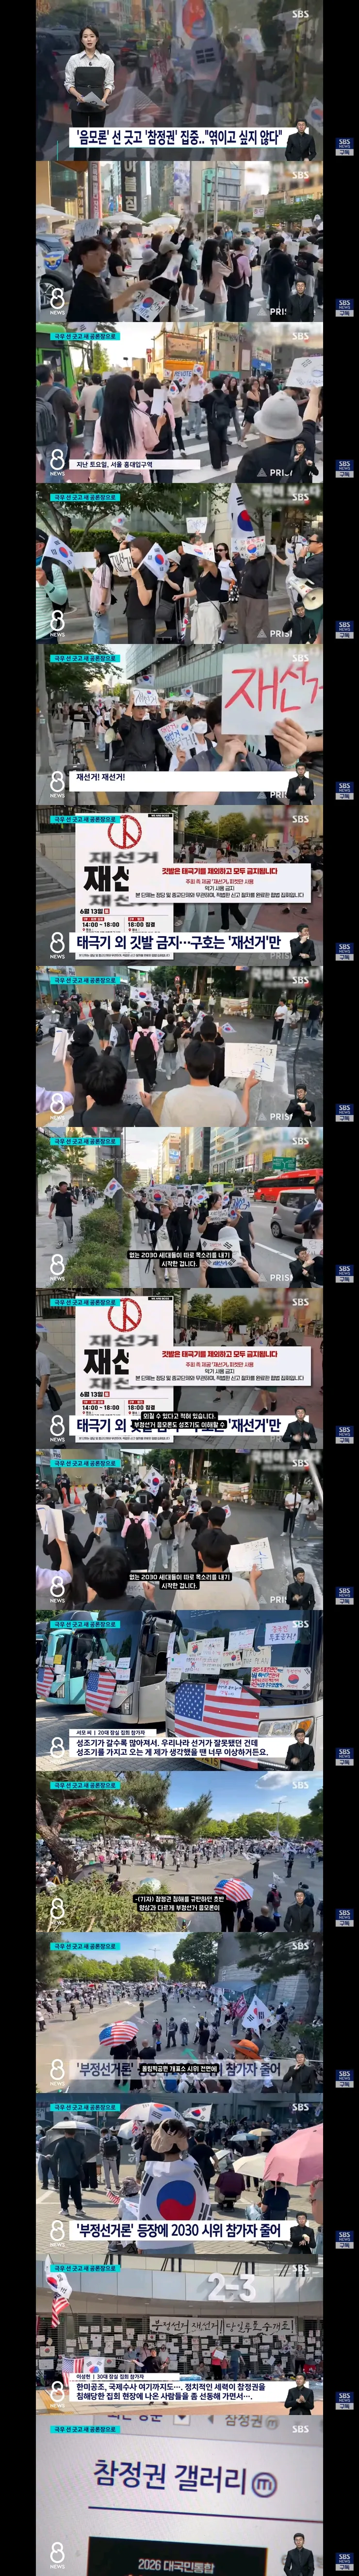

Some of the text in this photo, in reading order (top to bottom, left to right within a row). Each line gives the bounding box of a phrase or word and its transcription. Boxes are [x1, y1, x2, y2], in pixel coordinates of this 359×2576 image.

[134, 689, 157, 704] 재선거
[161, 724, 176, 734] 재선거
[164, 730, 180, 742] 재선거
[83, 866, 129, 891] 재선
[232, 1198, 250, 1210] 재선거
[269, 1633, 295, 1641] 투표금지!
[245, 1649, 264, 1657] TRUST
[208, 2273, 256, 2301] 2-3
[152, 2319, 223, 2336] 부정선거 재선거!
[226, 2320, 294, 2333] 당일투표 수개표!
[94, 2459, 247, 2495] 참정권 갤러리
[138, 2559, 215, 2575] 2026 대국민통합
